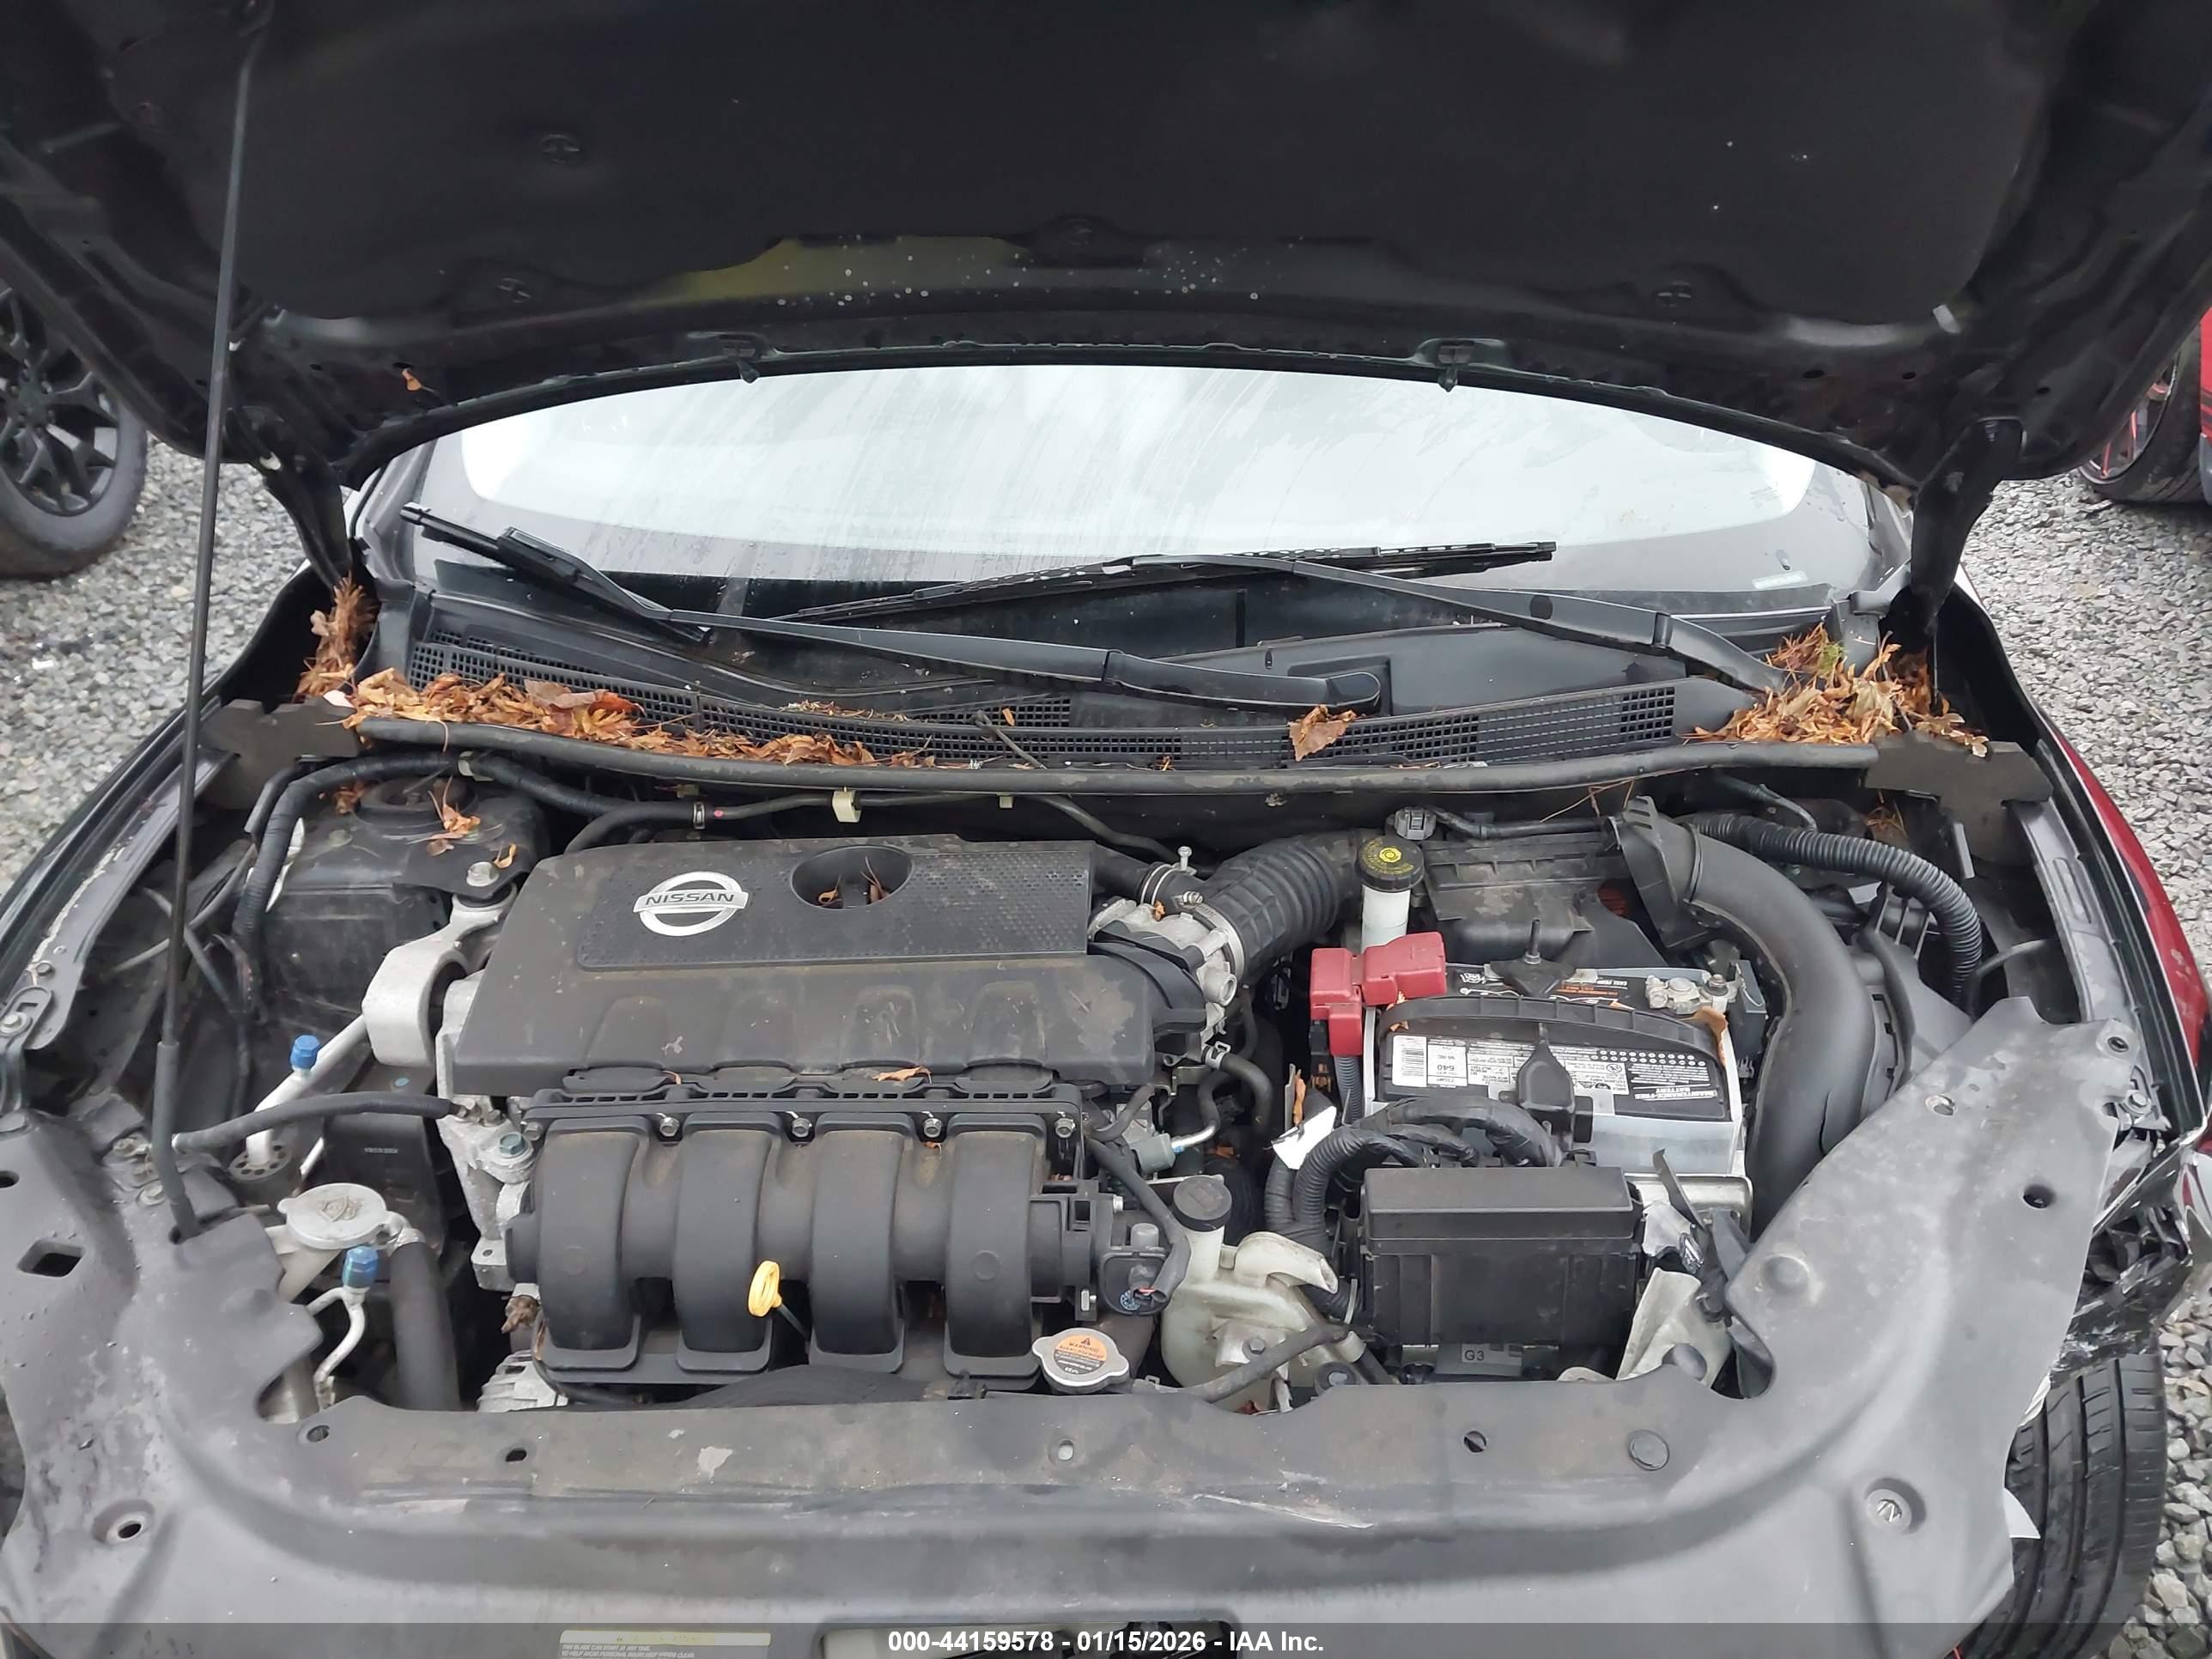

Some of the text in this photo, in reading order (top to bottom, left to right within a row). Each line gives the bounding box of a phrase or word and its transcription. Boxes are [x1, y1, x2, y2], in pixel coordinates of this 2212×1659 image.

[645, 892, 736, 906] NISSAN
[1069, 1341, 1099, 1353] WARNING
[1464, 1349, 1485, 1361] G3
